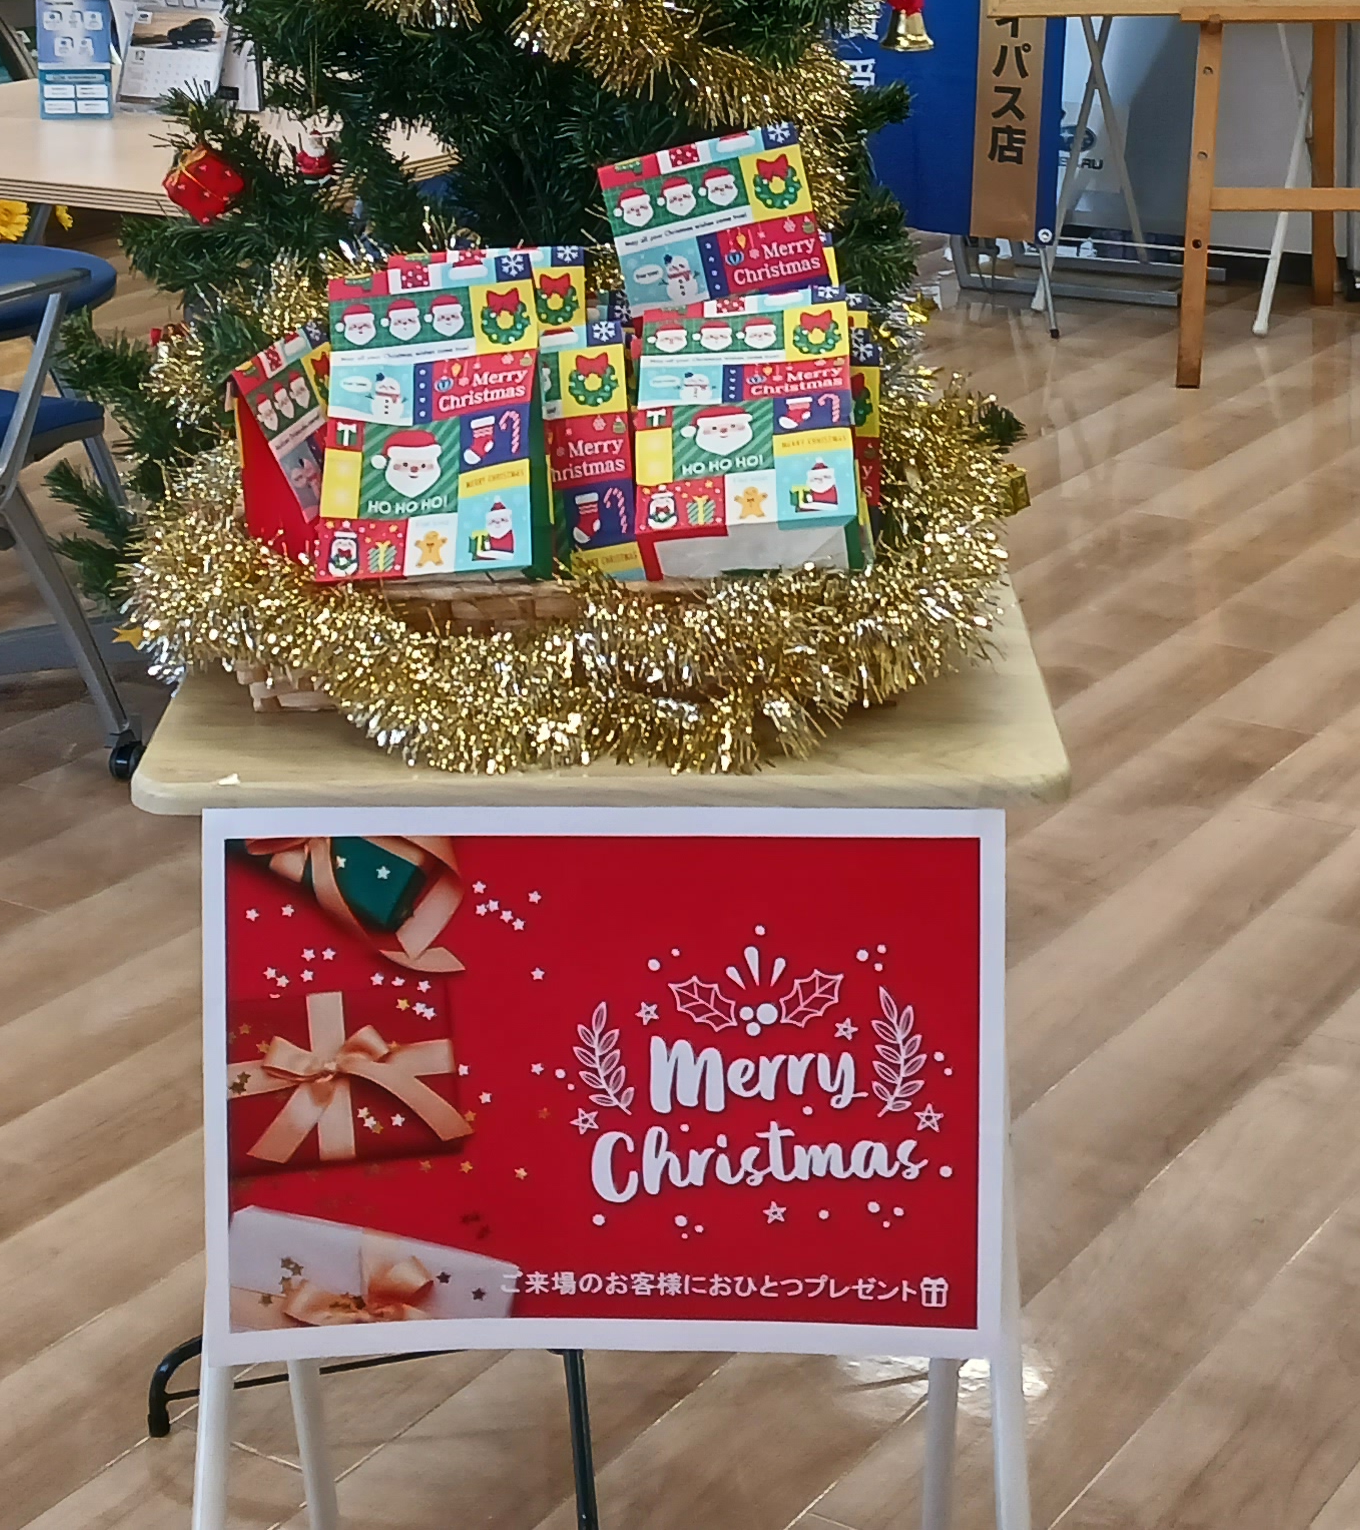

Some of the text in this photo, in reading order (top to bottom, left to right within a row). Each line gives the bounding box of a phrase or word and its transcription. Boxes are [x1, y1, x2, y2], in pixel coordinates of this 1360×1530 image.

[762, 237, 816, 260] Merry
[733, 256, 821, 286] Christmas
[472, 369, 528, 387] Merry
[786, 367, 843, 383] Merry
[751, 377, 843, 396] Christmas
[438, 384, 526, 412] Christmas
[568, 438, 624, 458] Merry
[682, 454, 764, 476] HO HO HO!
[465, 470, 525, 489] MERRY CHRISTMAS
[367, 495, 449, 514] HO HO HO!
[648, 1034, 869, 1113] Merry
[591, 1120, 928, 1204] Christmas
[499, 1269, 918, 1302] ご来場のお客様におひとつプレゼント
